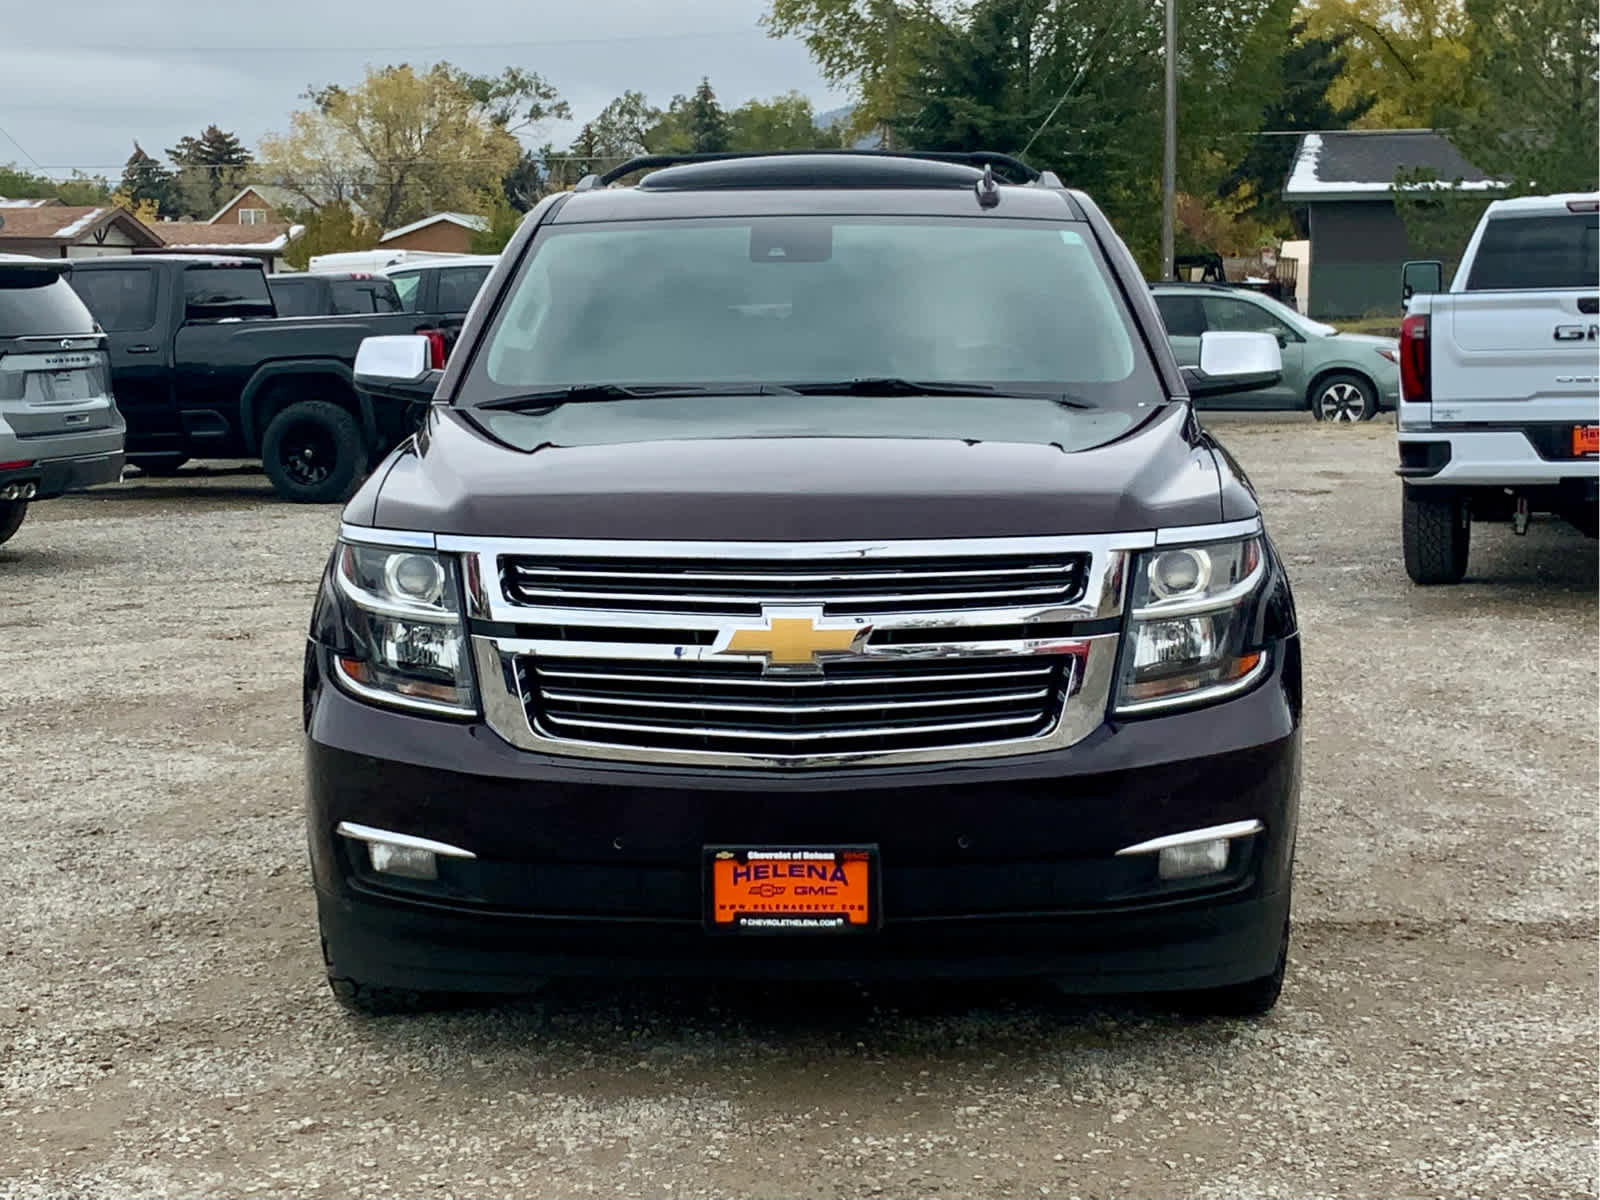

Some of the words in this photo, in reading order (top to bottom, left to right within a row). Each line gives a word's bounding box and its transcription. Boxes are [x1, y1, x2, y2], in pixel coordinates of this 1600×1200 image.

[792, 850, 802, 860] of
[732, 863, 848, 886] HELENA
[793, 886, 838, 896] GMC
